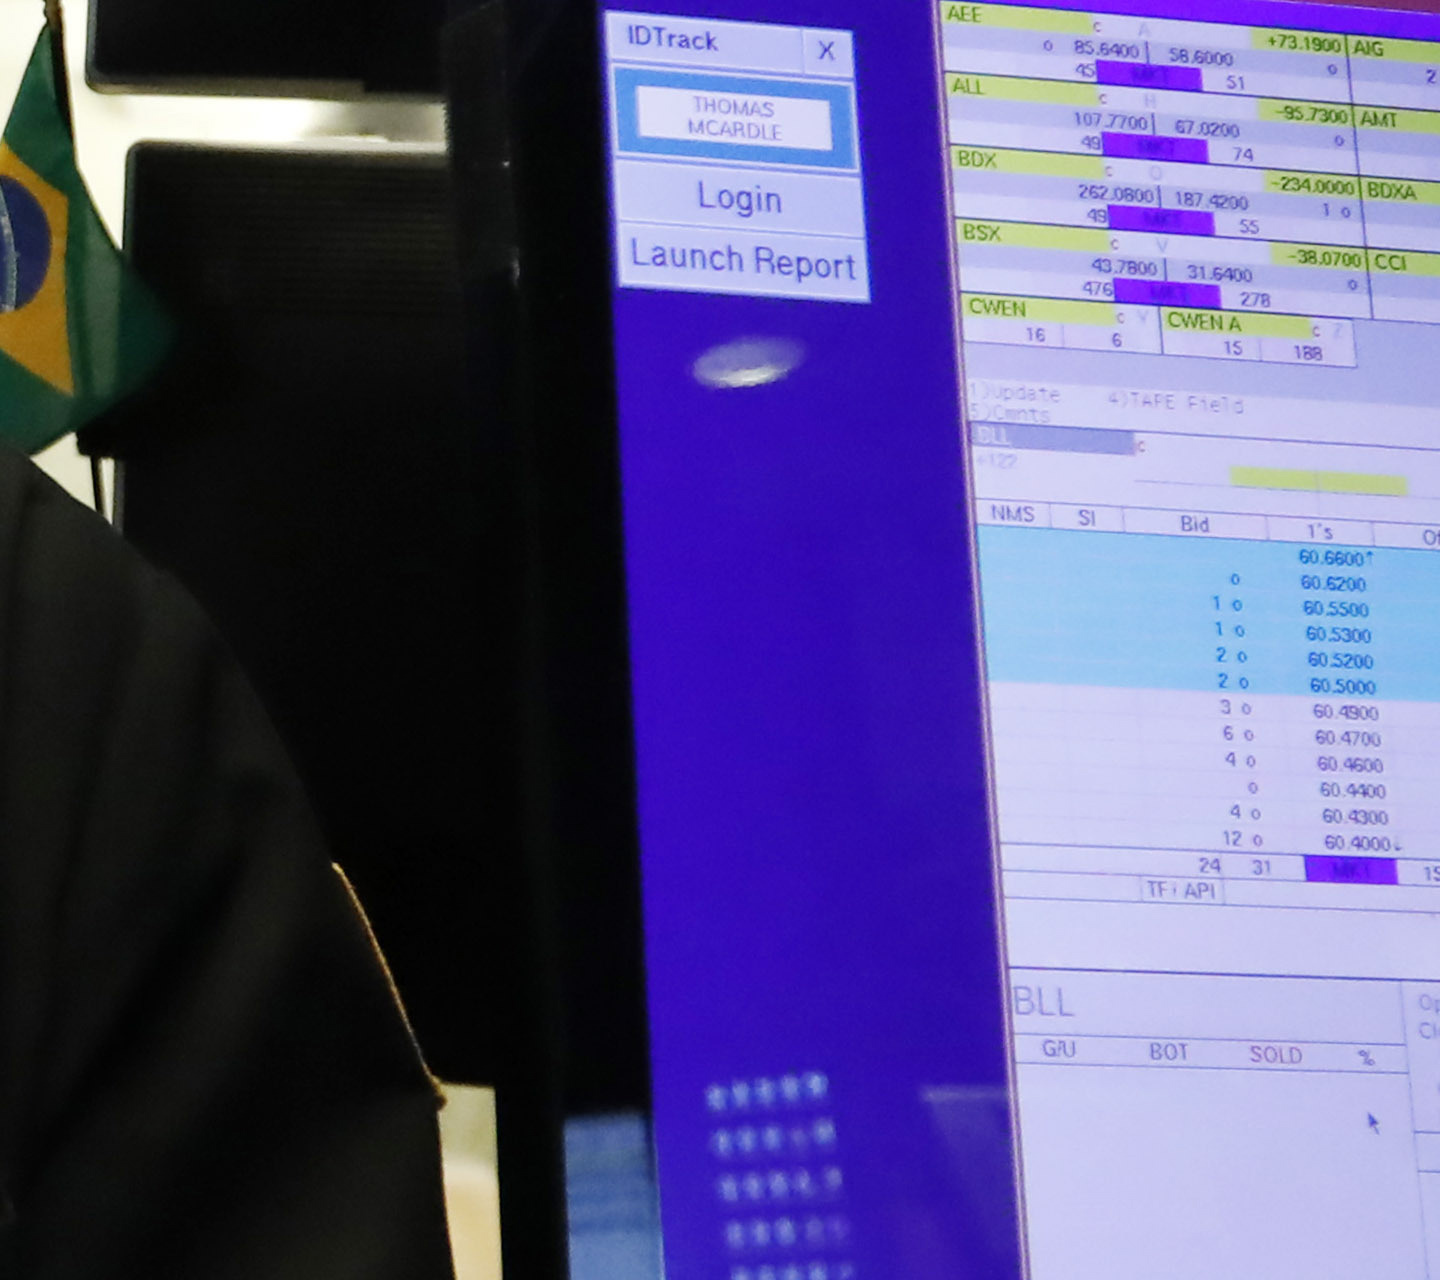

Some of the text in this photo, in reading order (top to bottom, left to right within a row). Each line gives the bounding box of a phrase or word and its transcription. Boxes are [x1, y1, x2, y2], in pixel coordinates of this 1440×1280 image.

[947, 5, 983, 23] AEE
[626, 26, 719, 53] IDTrack
[1074, 39, 1140, 59] 85.6400
[1268, 34, 1342, 53] +73.1900
[1354, 41, 1384, 57] AIG
[952, 78, 985, 95] ALL
[1226, 75, 1245, 90] 51
[692, 95, 775, 118] THOMAS
[1075, 112, 1148, 131] 107.7700
[1360, 110, 1397, 128] AMT
[688, 118, 783, 143] MCARDLE
[958, 149, 997, 169] BDX
[1232, 147, 1254, 162] 74
[1271, 176, 1355, 196] -234.0000
[1368, 181, 1418, 200] BDXA
[696, 181, 782, 216] Login
[963, 223, 1002, 242] BSX
[1239, 219, 1260, 235] 55
[631, 237, 855, 282] Launch Report
[1287, 249, 1362, 268] -38.0700
[1374, 253, 1407, 272] CCI
[1187, 264, 1253, 283] 31.6400
[1082, 281, 1114, 297] 476
[1240, 292, 1271, 308] 278
[969, 297, 1027, 318] CWEN
[1167, 310, 1224, 332] CWEN
[1229, 316, 1242, 333] A
[1026, 327, 1123, 348] 16 6
[1223, 340, 1243, 356] 15
[991, 504, 1036, 523] NMS
[1180, 515, 1210, 532] Bid
[1301, 575, 1366, 592] 60.6200
[1303, 600, 1369, 618] 60.5500
[1306, 626, 1372, 644] 60.5300
[1308, 652, 1374, 670] 60.5200
[1310, 677, 1376, 695] 60.5000
[1313, 703, 1379, 721] 60.4900
[1315, 730, 1382, 747] 60.4700
[1317, 756, 1384, 774] 60.4600
[1320, 782, 1386, 799] 60.4400
[1322, 808, 1389, 826] 60.4300
[1325, 835, 1391, 852] 60.4000
[1199, 857, 1221, 873] 24
[1252, 860, 1271, 875] 31
[1184, 882, 1216, 900] API
[1013, 985, 1075, 1018] BLL
[1150, 1042, 1189, 1062] BOT
[1249, 1044, 1304, 1065] SOLD
[1357, 1050, 1375, 1066] %
